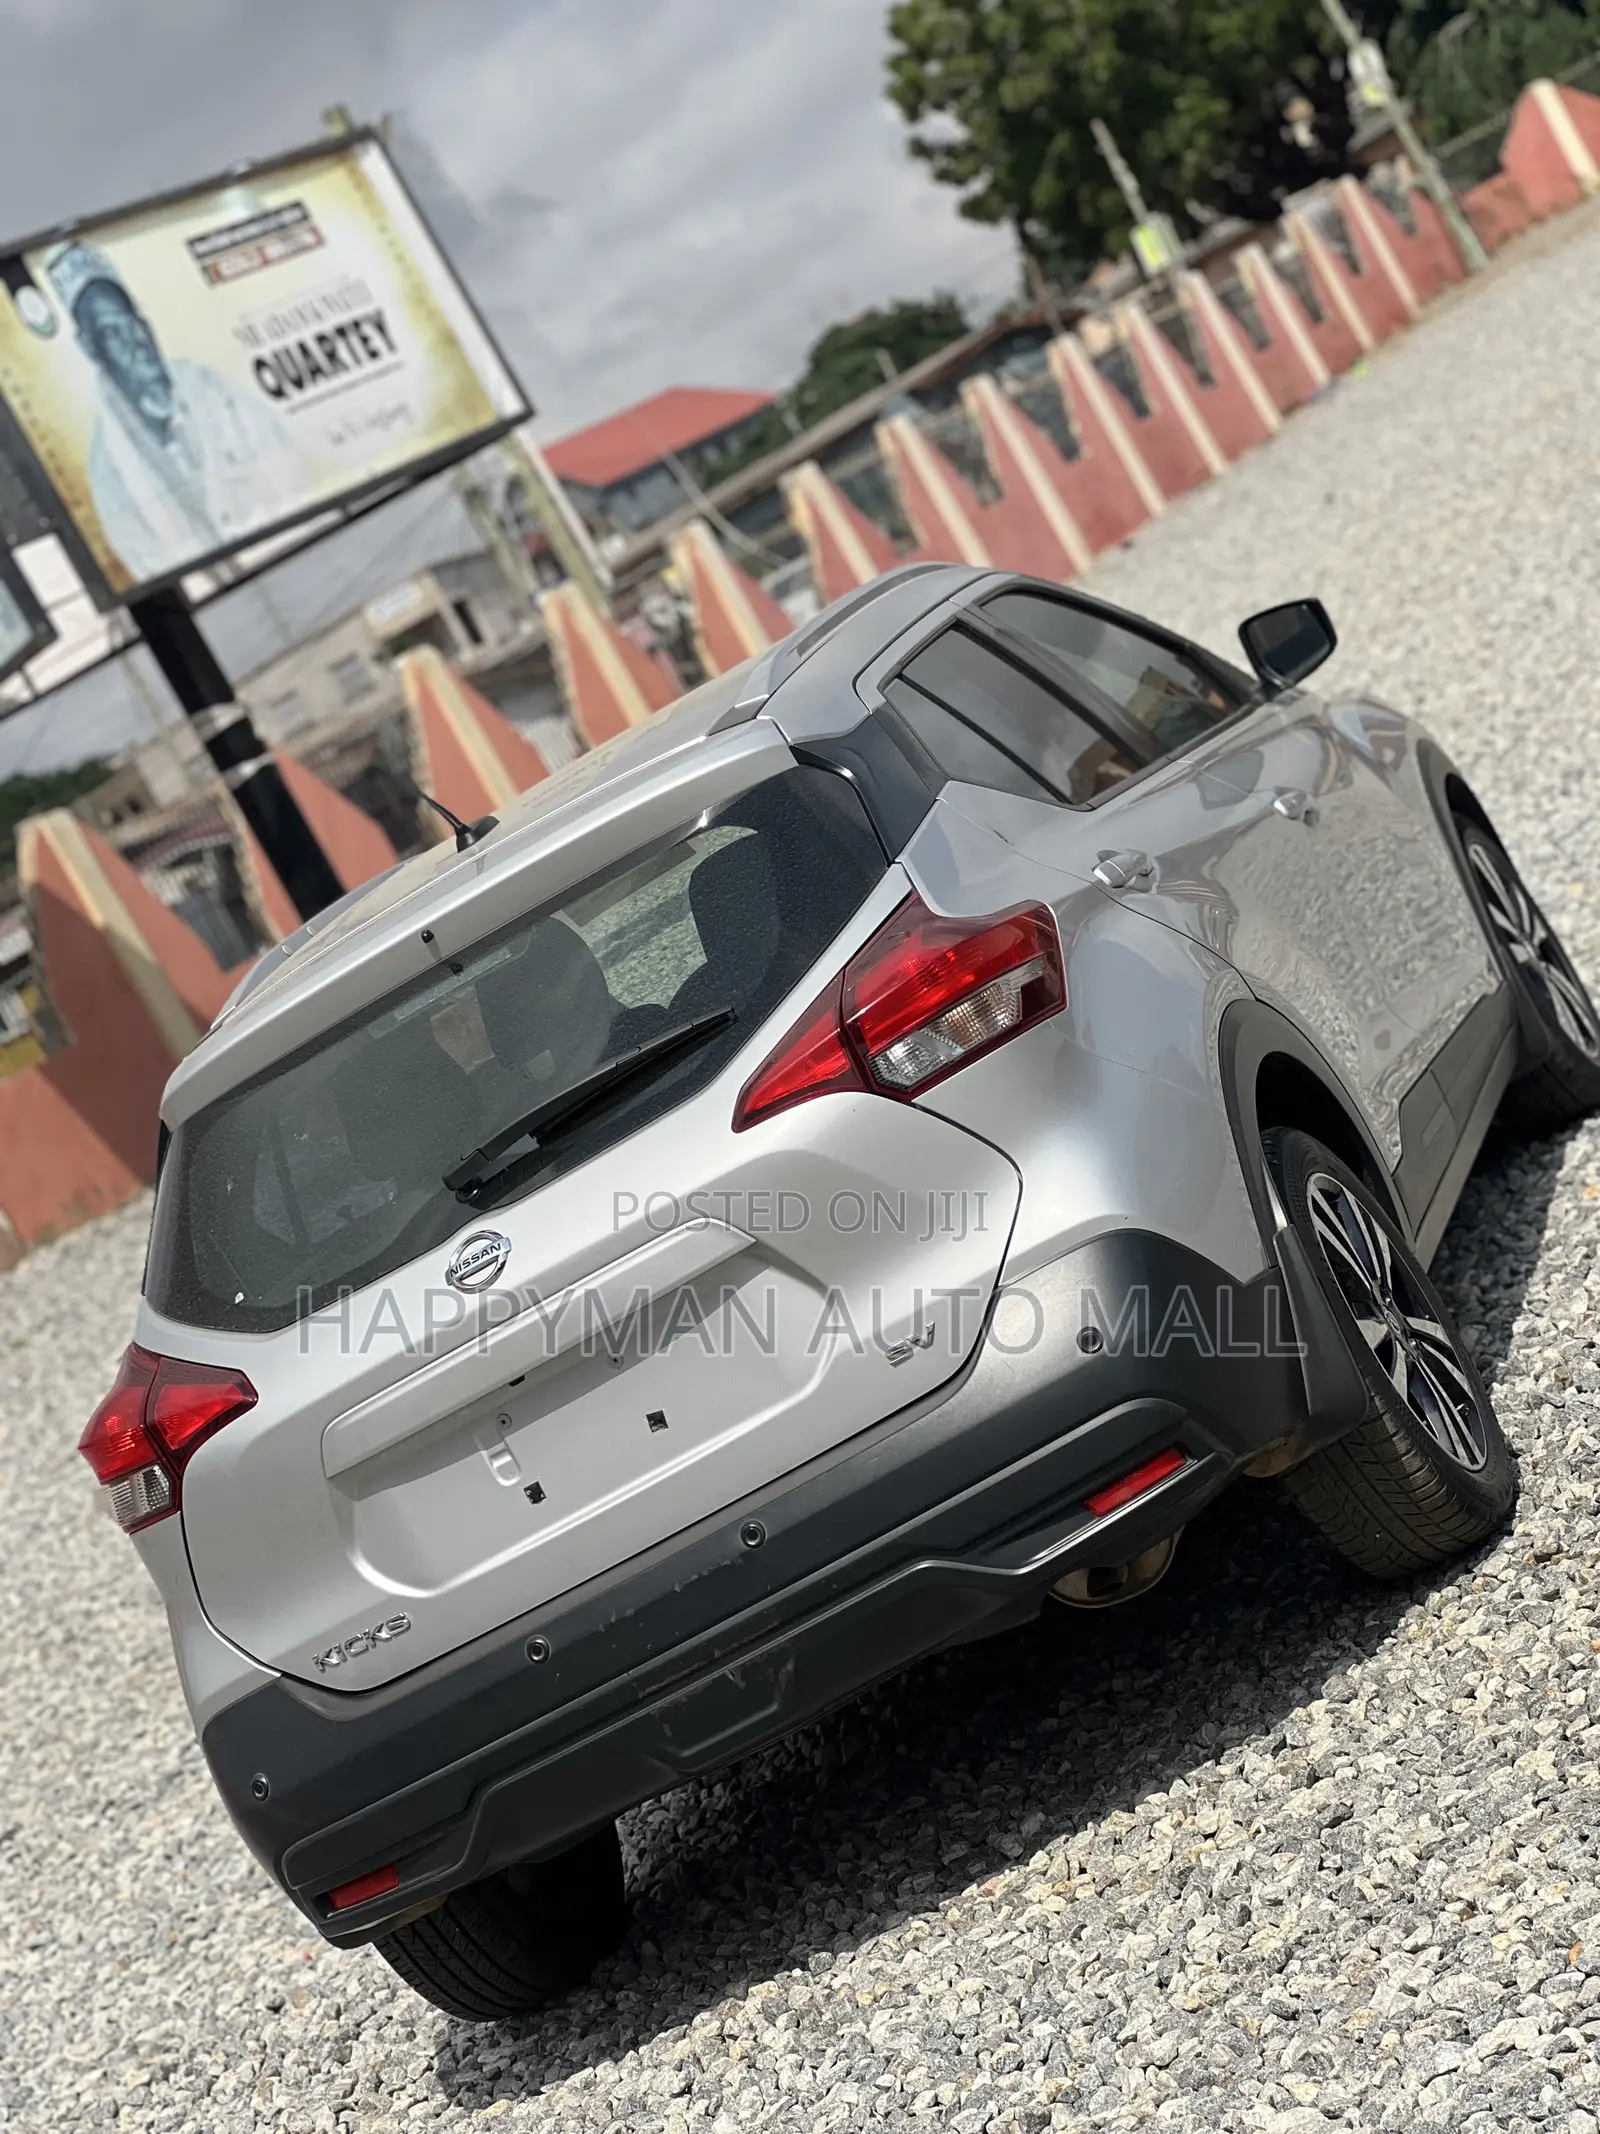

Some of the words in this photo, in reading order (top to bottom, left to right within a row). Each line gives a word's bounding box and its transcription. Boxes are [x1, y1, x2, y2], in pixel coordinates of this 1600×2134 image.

[253, 306, 398, 401] QUARTEY
[449, 1242, 502, 1278] NISSAN
[886, 1320, 936, 1368] SV
[311, 1612, 412, 1673] KICKS
